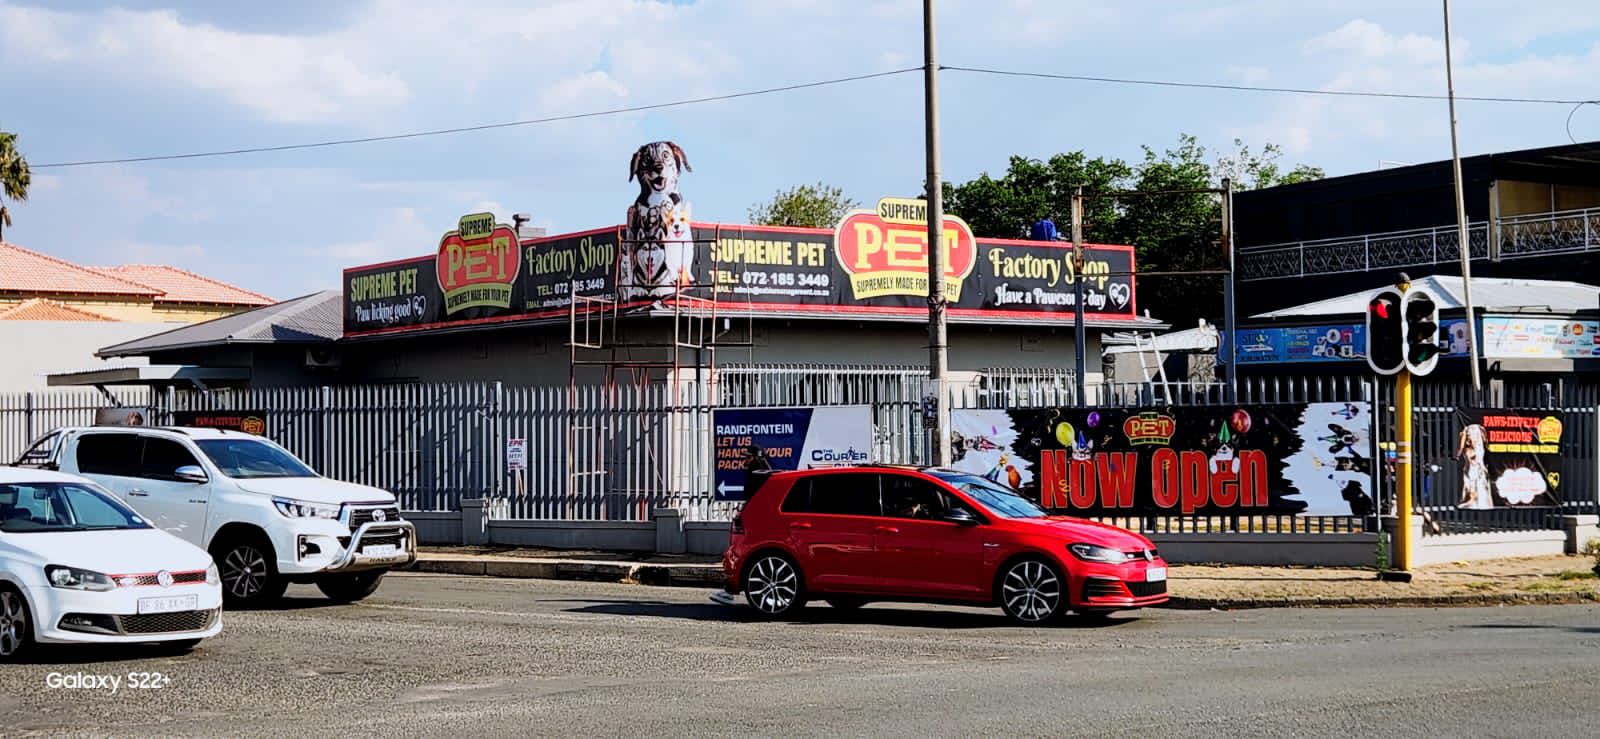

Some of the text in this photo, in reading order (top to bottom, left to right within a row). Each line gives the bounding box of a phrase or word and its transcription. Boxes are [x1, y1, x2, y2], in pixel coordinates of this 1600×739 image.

[881, 202, 927, 221] SUPREM
[460, 218, 492, 237] SUPREME
[526, 236, 614, 279] Factory Shop
[710, 239, 826, 266] SUPREME PET
[853, 222, 959, 273] PET
[446, 236, 509, 286] PET
[988, 248, 1109, 290] Factory Sop
[351, 268, 417, 303] SUPREME PET
[537, 277, 605, 297] TEL: 072 85 3449
[708, 270, 830, 287] TEL: 072 185 3449
[857, 277, 958, 297] SUPREMELY MADE FOR PET
[995, 283, 1023, 306] Have
[1025, 292, 1032, 304] a
[1087, 289, 1106, 310] day
[355, 298, 411, 323] Paw licking good
[716, 424, 794, 435] RANDFONTEIN
[1130, 420, 1169, 437] PET
[1489, 431, 1533, 443] DELICIOUS
[717, 436, 752, 447] LET US
[1151, 448, 1269, 514] Open
